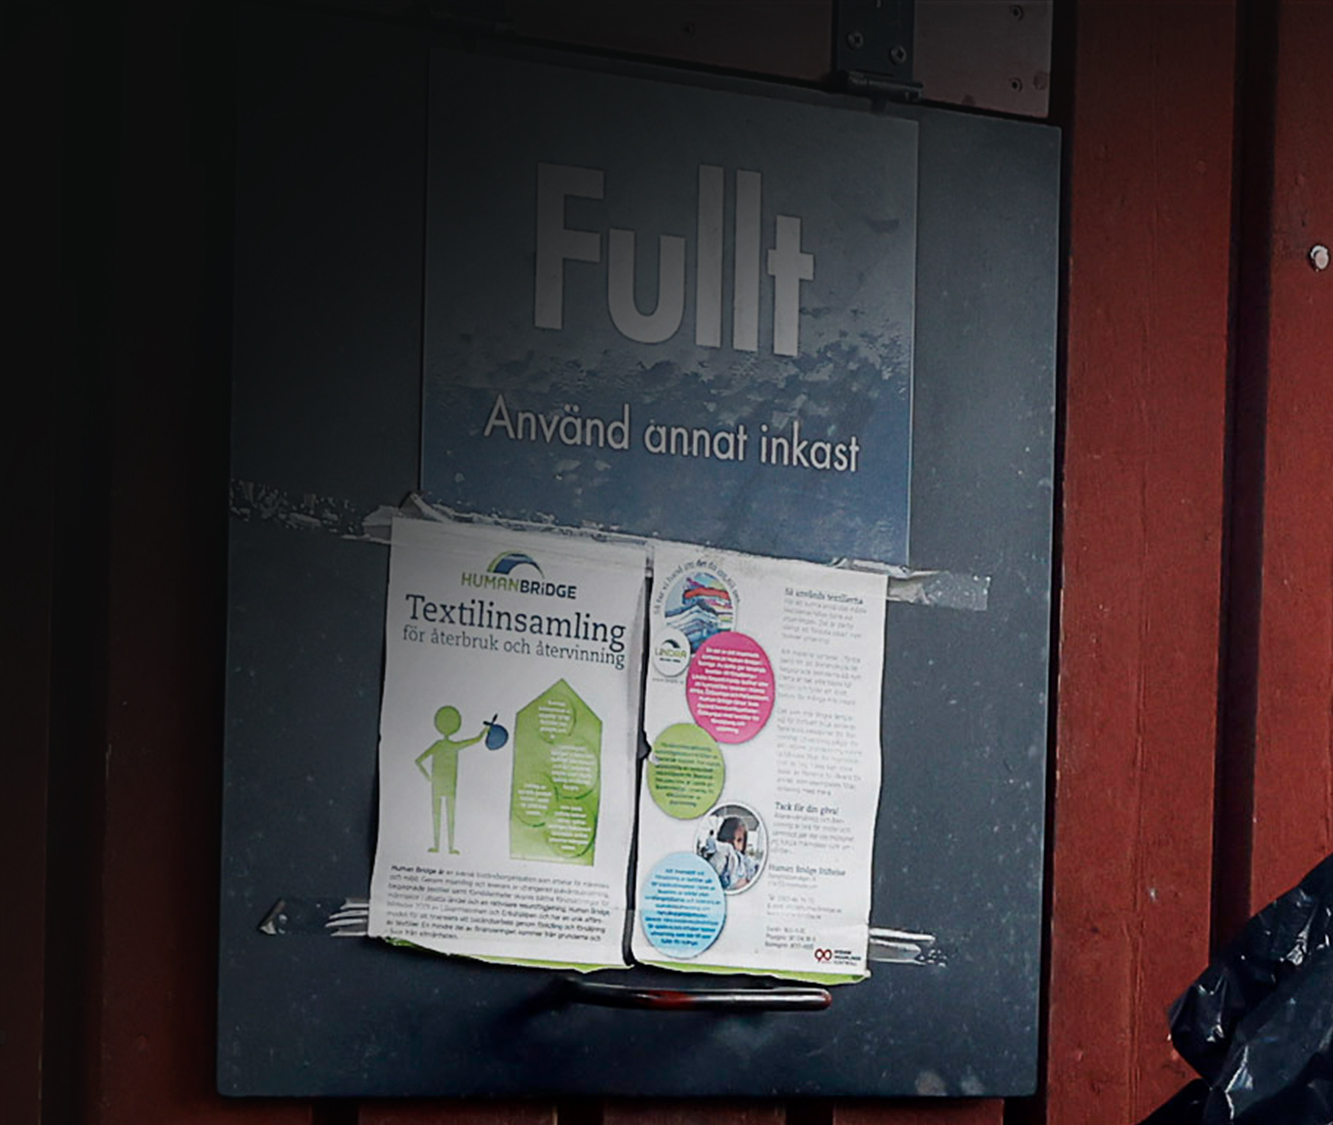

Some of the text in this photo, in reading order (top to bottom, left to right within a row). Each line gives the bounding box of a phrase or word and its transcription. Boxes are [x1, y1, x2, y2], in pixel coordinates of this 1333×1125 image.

[534, 162, 814, 356] Fullt
[483, 393, 860, 472] Använd annat inkast
[403, 624, 625, 670] för återbruk och återvinning
[405, 594, 627, 653] Textilinsamling
